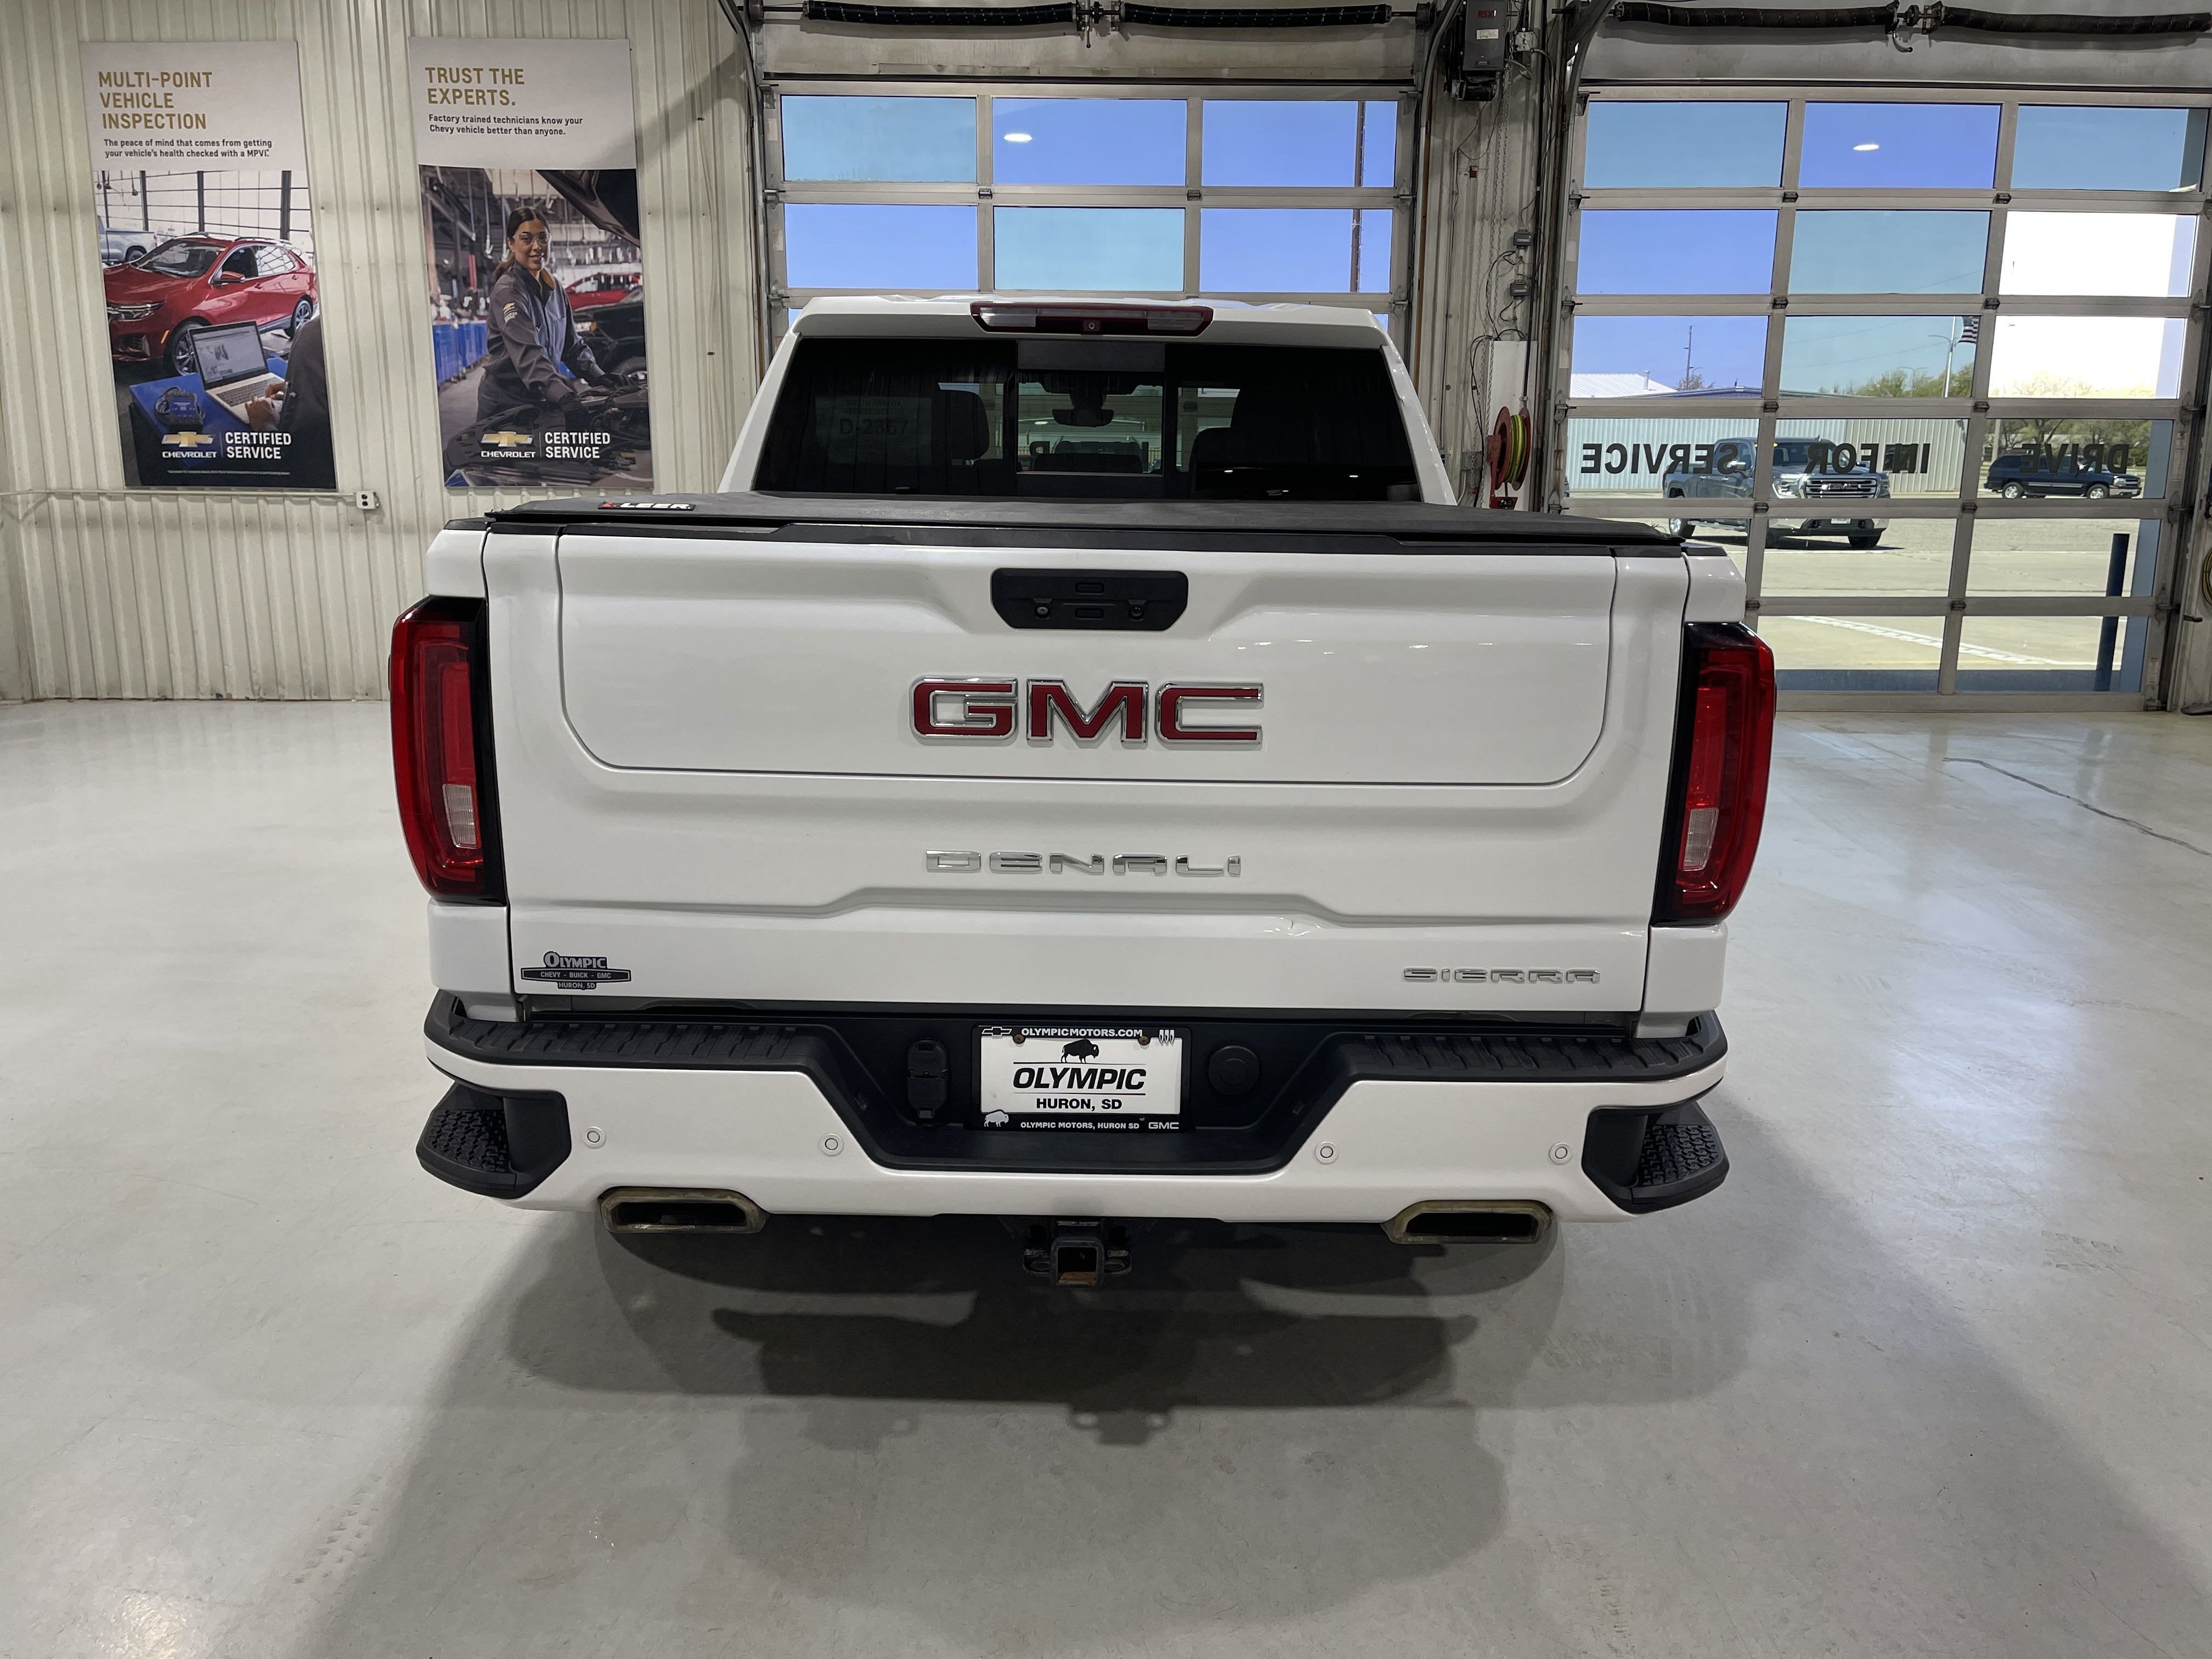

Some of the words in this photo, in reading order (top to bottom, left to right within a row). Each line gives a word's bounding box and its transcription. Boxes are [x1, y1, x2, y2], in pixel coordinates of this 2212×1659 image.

[98, 71, 212, 88] MULTI-POINT
[425, 67, 483, 83] TRUST
[489, 68, 525, 84] THE
[100, 92, 174, 108] VEHICLE
[427, 88, 516, 106] EXPERTS.
[102, 113, 206, 129] INSPECTION
[429, 114, 460, 124] Factory
[462, 115, 491, 123] trained
[493, 116, 539, 124] technicians
[565, 118, 583, 126] your
[430, 124, 454, 134] Chevy
[456, 125, 485, 133] vehicle
[487, 126, 512, 134] better
[514, 127, 533, 135] than
[534, 128, 566, 137] anyone.
[120, 140, 143, 148] peace
[145, 138, 153, 146] of
[243, 139, 272, 148] getting
[225, 431, 292, 446] CERTIFIED
[545, 431, 611, 445] CERTIFIED
[162, 450, 218, 459] CHEVROLET
[227, 445, 281, 460] SERVICE
[481, 450, 537, 459] CHEVROLET
[545, 445, 600, 459] SERVICE
[909, 675, 1264, 744] GMC
[926, 849, 1242, 877] DENALI
[1403, 967, 1601, 984] SIERRA
[1021, 1028, 1143, 1037] OLYMPICMOTORS.COM
[1013, 1067, 1147, 1090] OLYMPIC
[1036, 1098, 1096, 1111] HURON,
[1101, 1099, 1122, 1110] SD
[1058, 1122, 1096, 1130] MOTORS,
